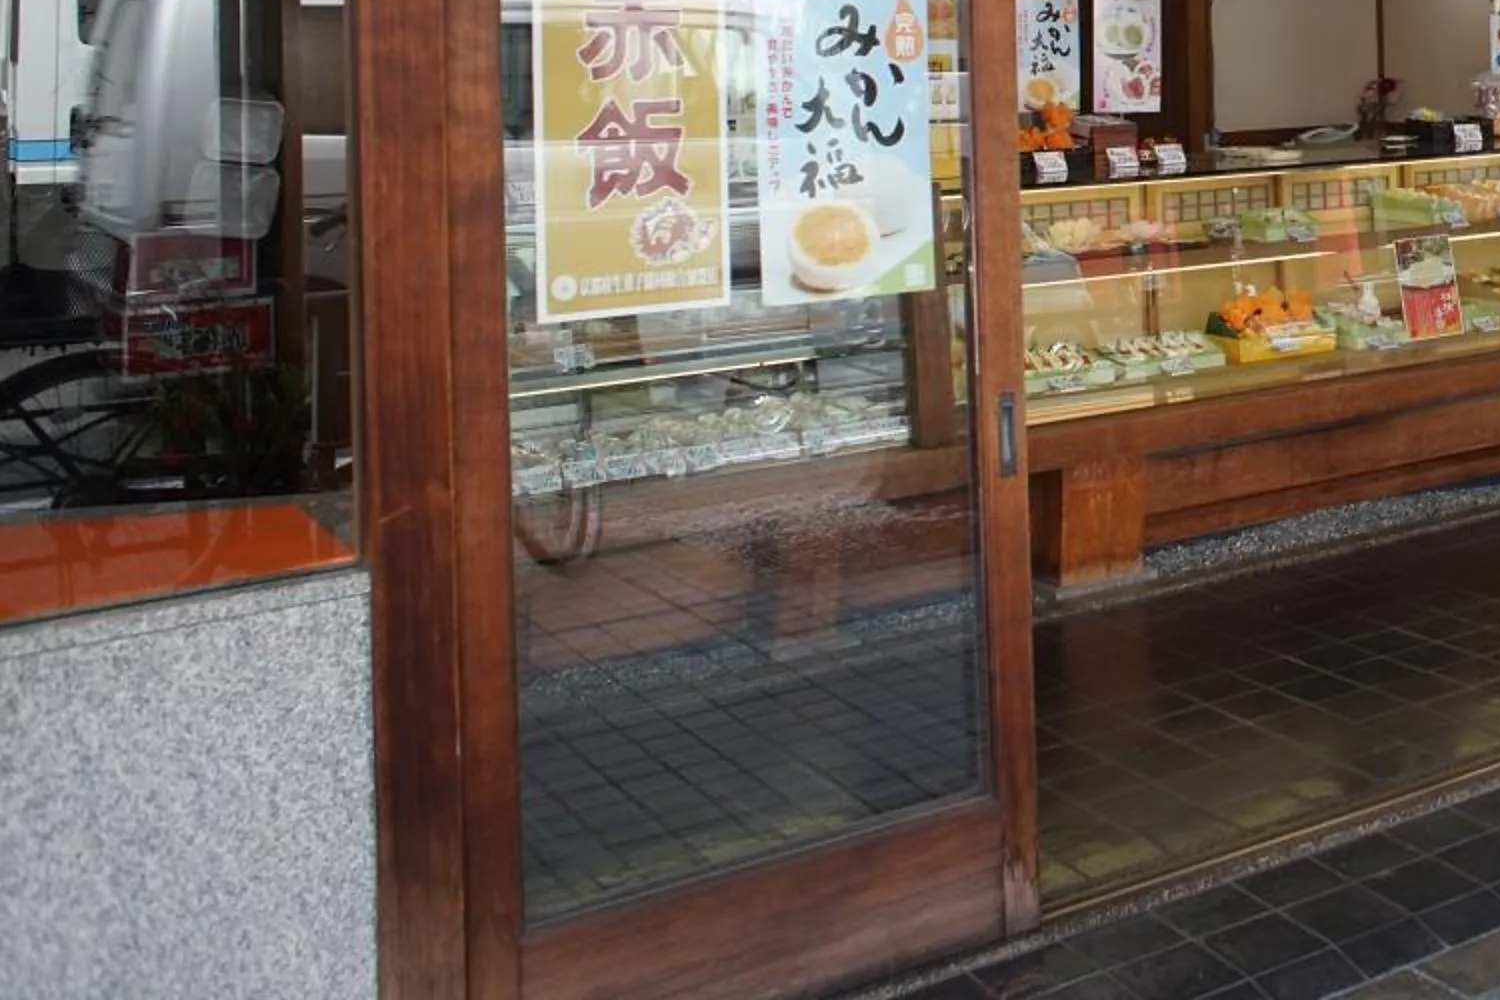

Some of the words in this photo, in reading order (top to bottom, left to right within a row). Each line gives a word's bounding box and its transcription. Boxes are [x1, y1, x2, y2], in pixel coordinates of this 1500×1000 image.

[815, 3, 906, 147] みかん
[1036, 1, 1072, 58] みかん
[793, 75, 865, 199] 大福
